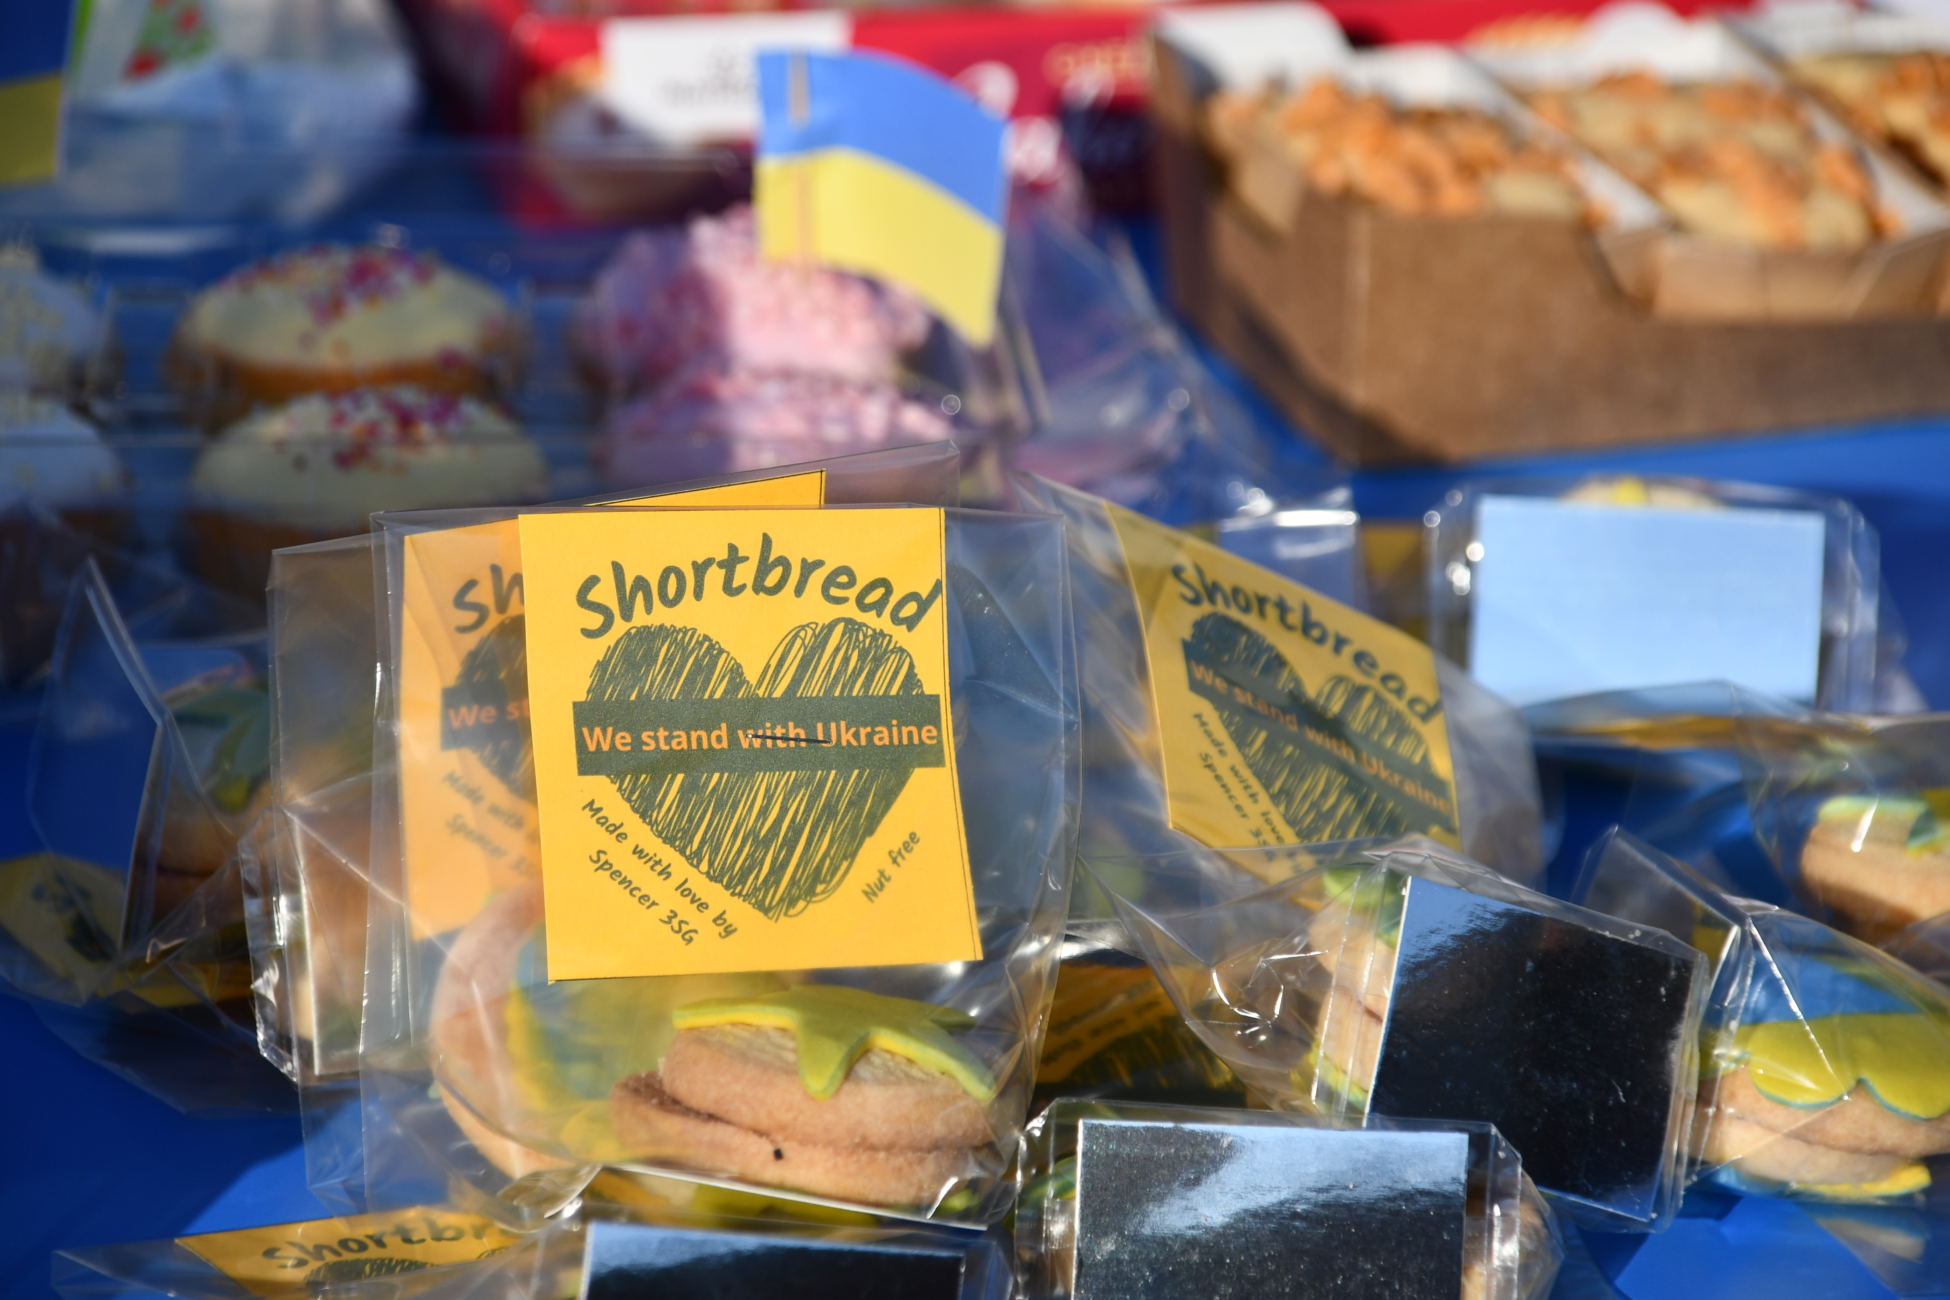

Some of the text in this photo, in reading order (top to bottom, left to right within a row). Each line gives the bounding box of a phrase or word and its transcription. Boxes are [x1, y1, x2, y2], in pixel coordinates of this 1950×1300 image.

[576, 532, 942, 639] Shortbread
[1171, 561, 1441, 725] Shortbread
[448, 703, 497, 731] We
[582, 719, 939, 752] We stand with Ukraine
[1190, 659, 1228, 695] We
[1232, 685, 1299, 732] stand
[1303, 724, 1356, 763] with
[1191, 712, 1286, 845] Made with love
[1199, 750, 1250, 820] Spencer
[582, 799, 628, 844] Made
[631, 843, 673, 881] with
[674, 877, 710, 914] love
[711, 909, 739, 940] by
[588, 849, 660, 911] Spencer
[861, 831, 921, 904] Nut free
